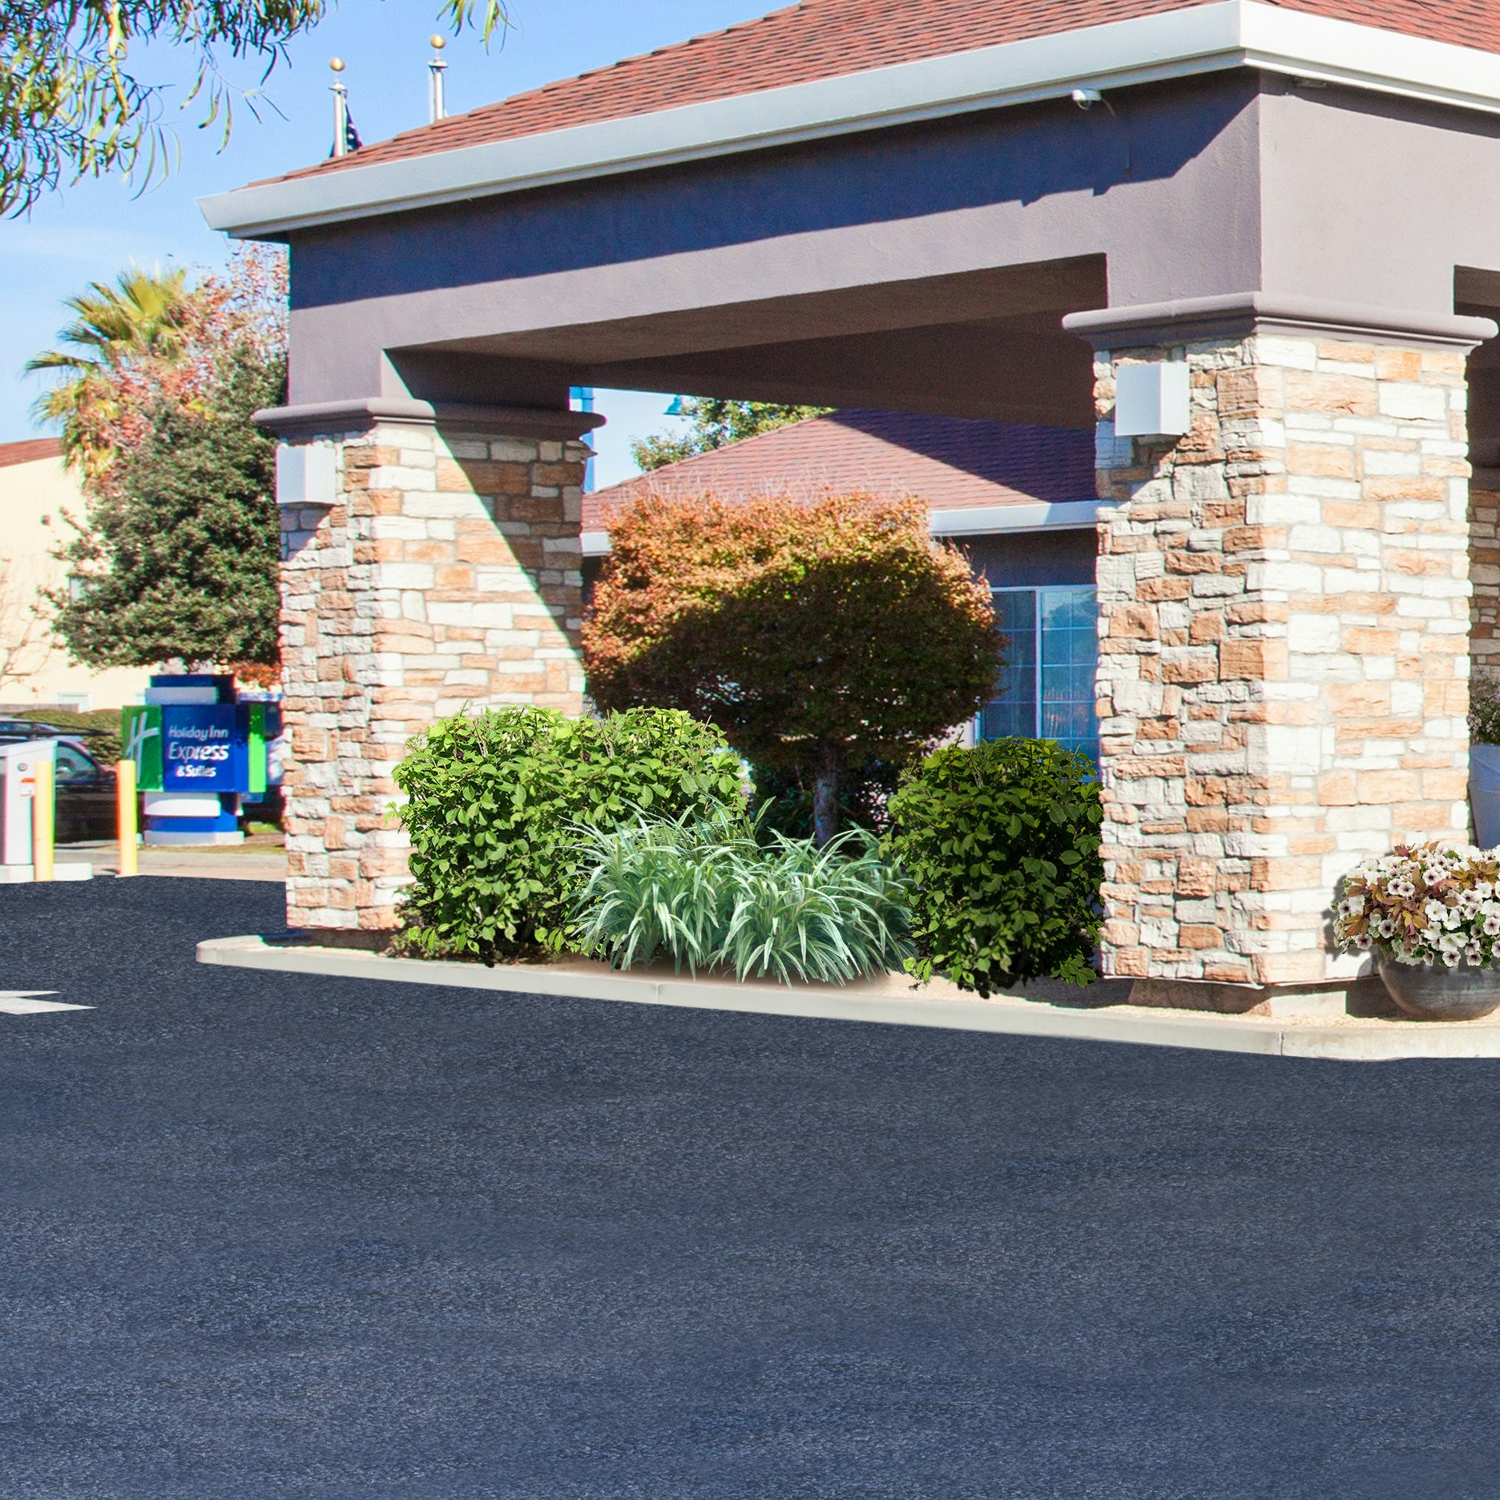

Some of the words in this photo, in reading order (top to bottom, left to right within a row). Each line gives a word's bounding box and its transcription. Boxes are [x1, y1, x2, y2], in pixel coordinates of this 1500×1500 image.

[168, 725, 208, 741] Holiday
[209, 725, 228, 739] Inn
[167, 742, 230, 764] Express
[185, 764, 216, 778] Suites
